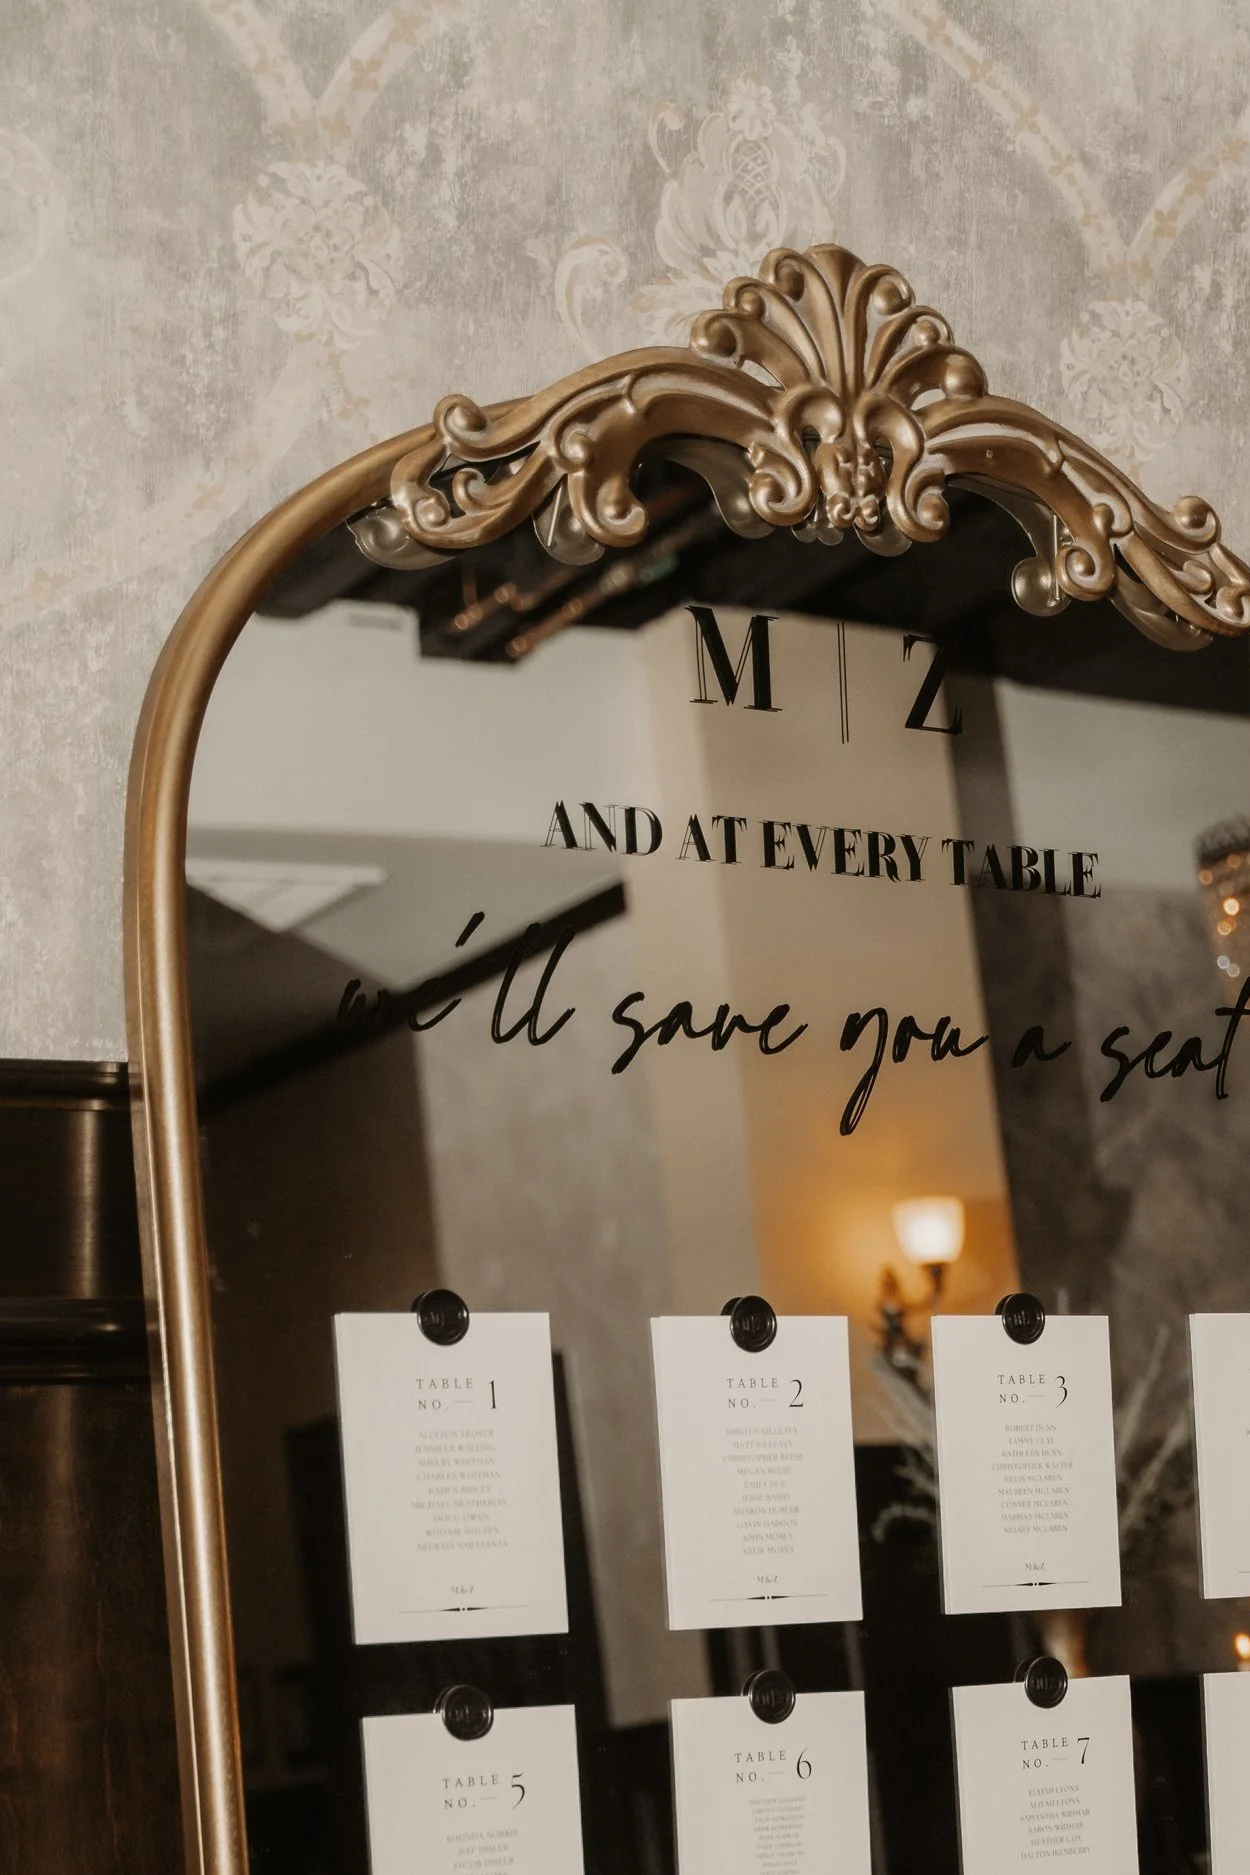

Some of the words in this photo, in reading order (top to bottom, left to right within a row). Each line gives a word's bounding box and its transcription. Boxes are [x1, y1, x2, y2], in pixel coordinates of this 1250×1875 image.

[684, 605, 783, 712] M
[903, 634, 963, 735] Z
[540, 800, 663, 857] AND
[675, 813, 748, 864] AT
[758, 820, 932, 882] EVERY
[942, 838, 1101, 899] TABLE
[338, 911, 576, 1046] we'll
[611, 992, 808, 1074] save
[840, 1007, 989, 1136] you
[1011, 1026, 1072, 1068] a
[416, 1378, 473, 1389] TABLE
[727, 1378, 778, 1388] TABLE
[789, 1379, 803, 1407] 2
[998, 1374, 1045, 1384] TABLE
[1056, 1376, 1067, 1408] 3
[489, 1380, 496, 1409] 1
[735, 1750, 786, 1763] TABLE
[1021, 1737, 1068, 1750] TABLE
[1077, 1737, 1089, 1764] 7
[797, 1748, 811, 1779] 6
[443, 1774, 499, 1789] TABLE
[512, 1772, 525, 1809] 5
